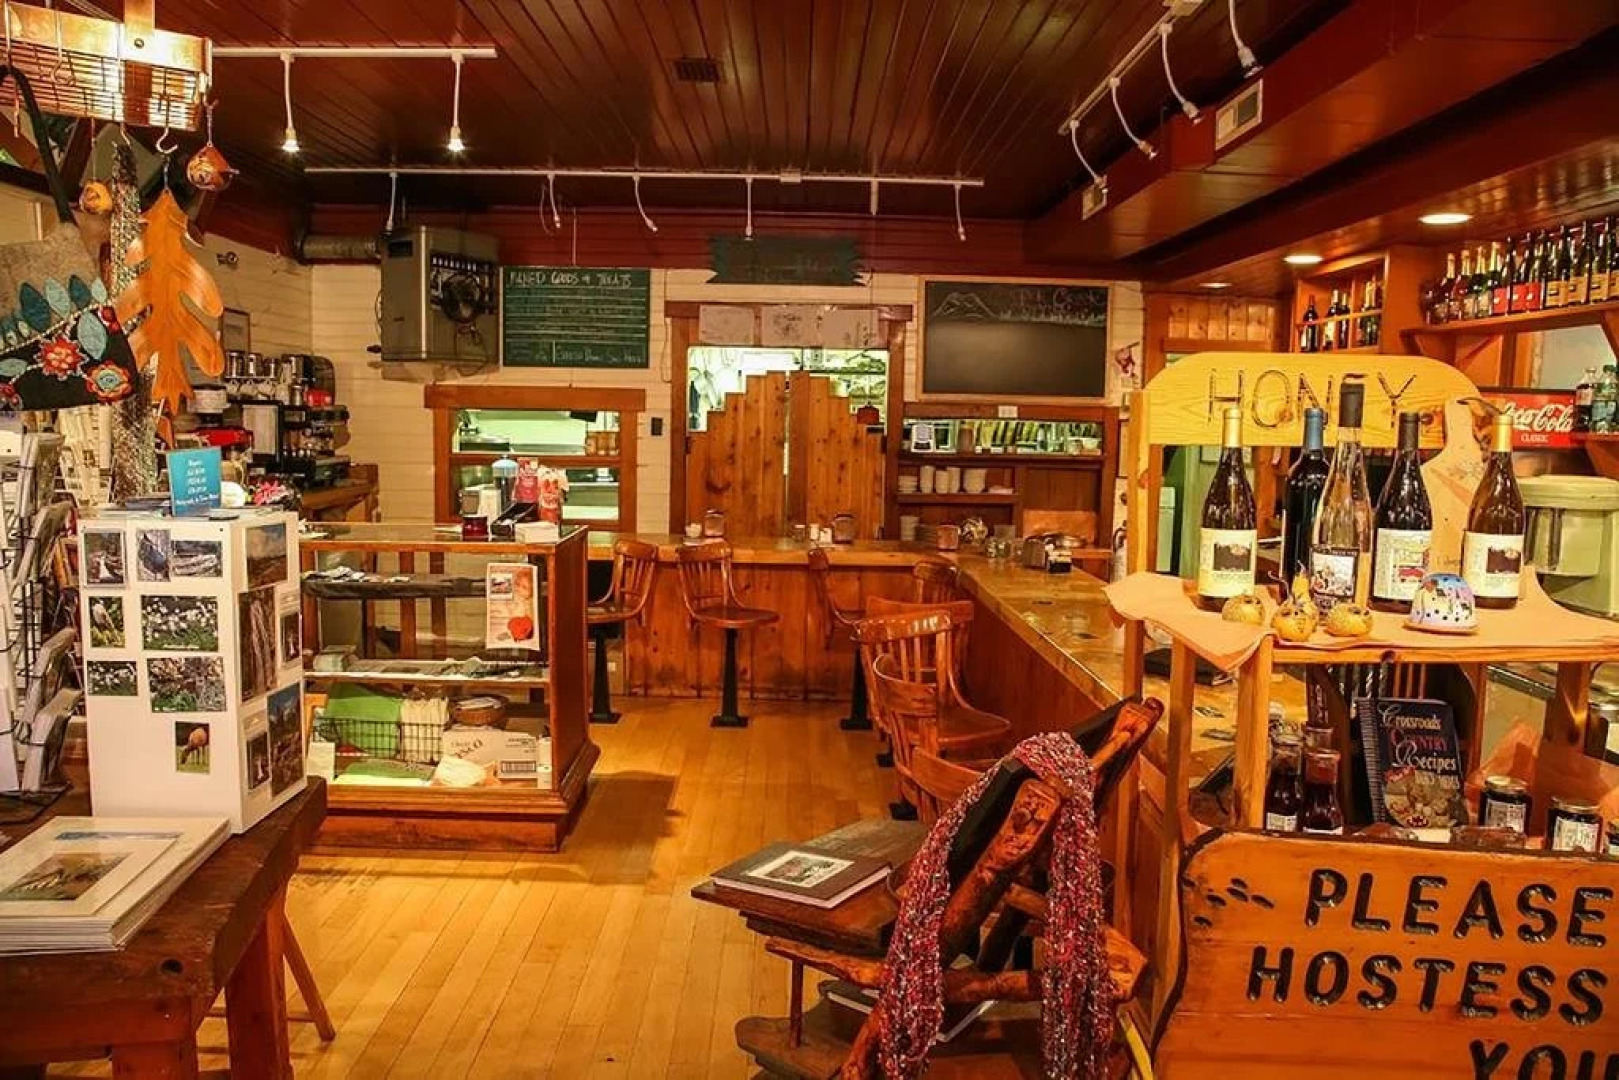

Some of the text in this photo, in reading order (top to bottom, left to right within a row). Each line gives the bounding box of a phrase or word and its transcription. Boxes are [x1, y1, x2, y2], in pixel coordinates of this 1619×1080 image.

[1207, 368, 1418, 429] HONY
[1391, 739, 1457, 774] Recipes
[1304, 868, 1615, 947] PLEASE
[1246, 946, 1609, 1027] HOSTESS
